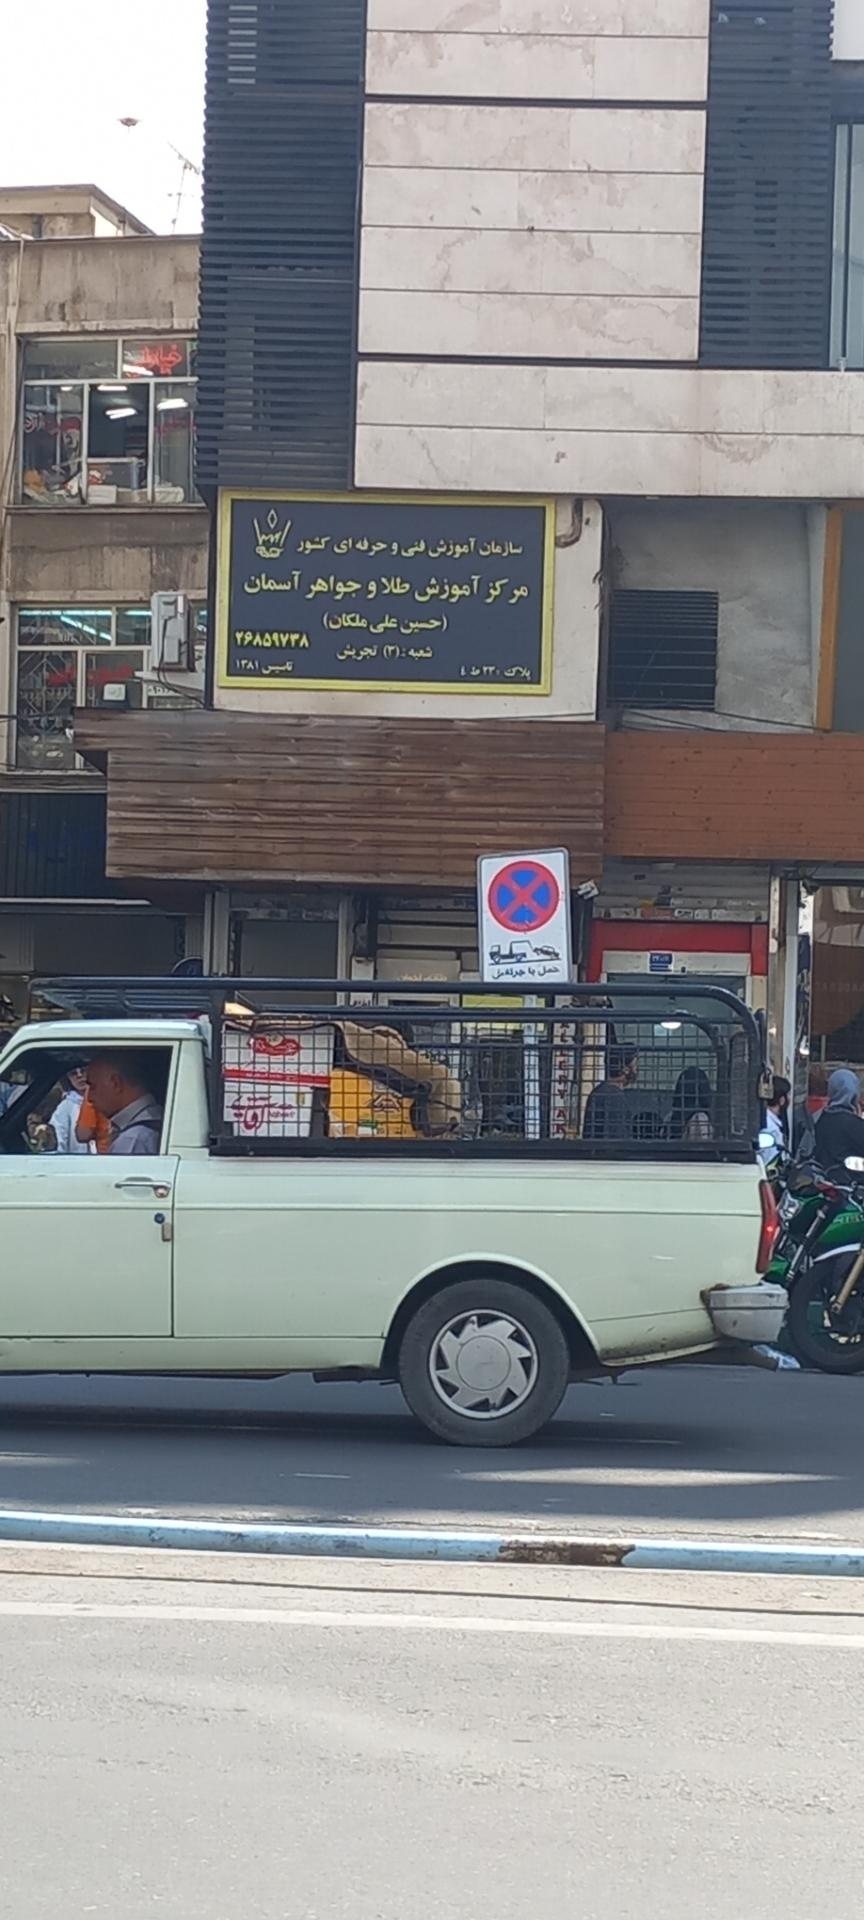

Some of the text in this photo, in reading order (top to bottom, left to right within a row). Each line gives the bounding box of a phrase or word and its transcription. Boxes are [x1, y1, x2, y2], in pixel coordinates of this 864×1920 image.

[297, 536, 523, 558] سازمان آموزش فنی و حرفه ای کشور
[244, 570, 529, 603] مرکز آموزش طلا و جواهر آسمان
[369, 613, 398, 633] علی
[235, 631, 309, 648] ۲۶۸۵۹۷۳۸
[336, 644, 377, 660] تجریش
[235, 659, 259, 670] ۱۳۸۱
[503, 666, 531, 681] پلاک
[527, 966, 536, 976] با
[537, 965, 560, 977] حمل
